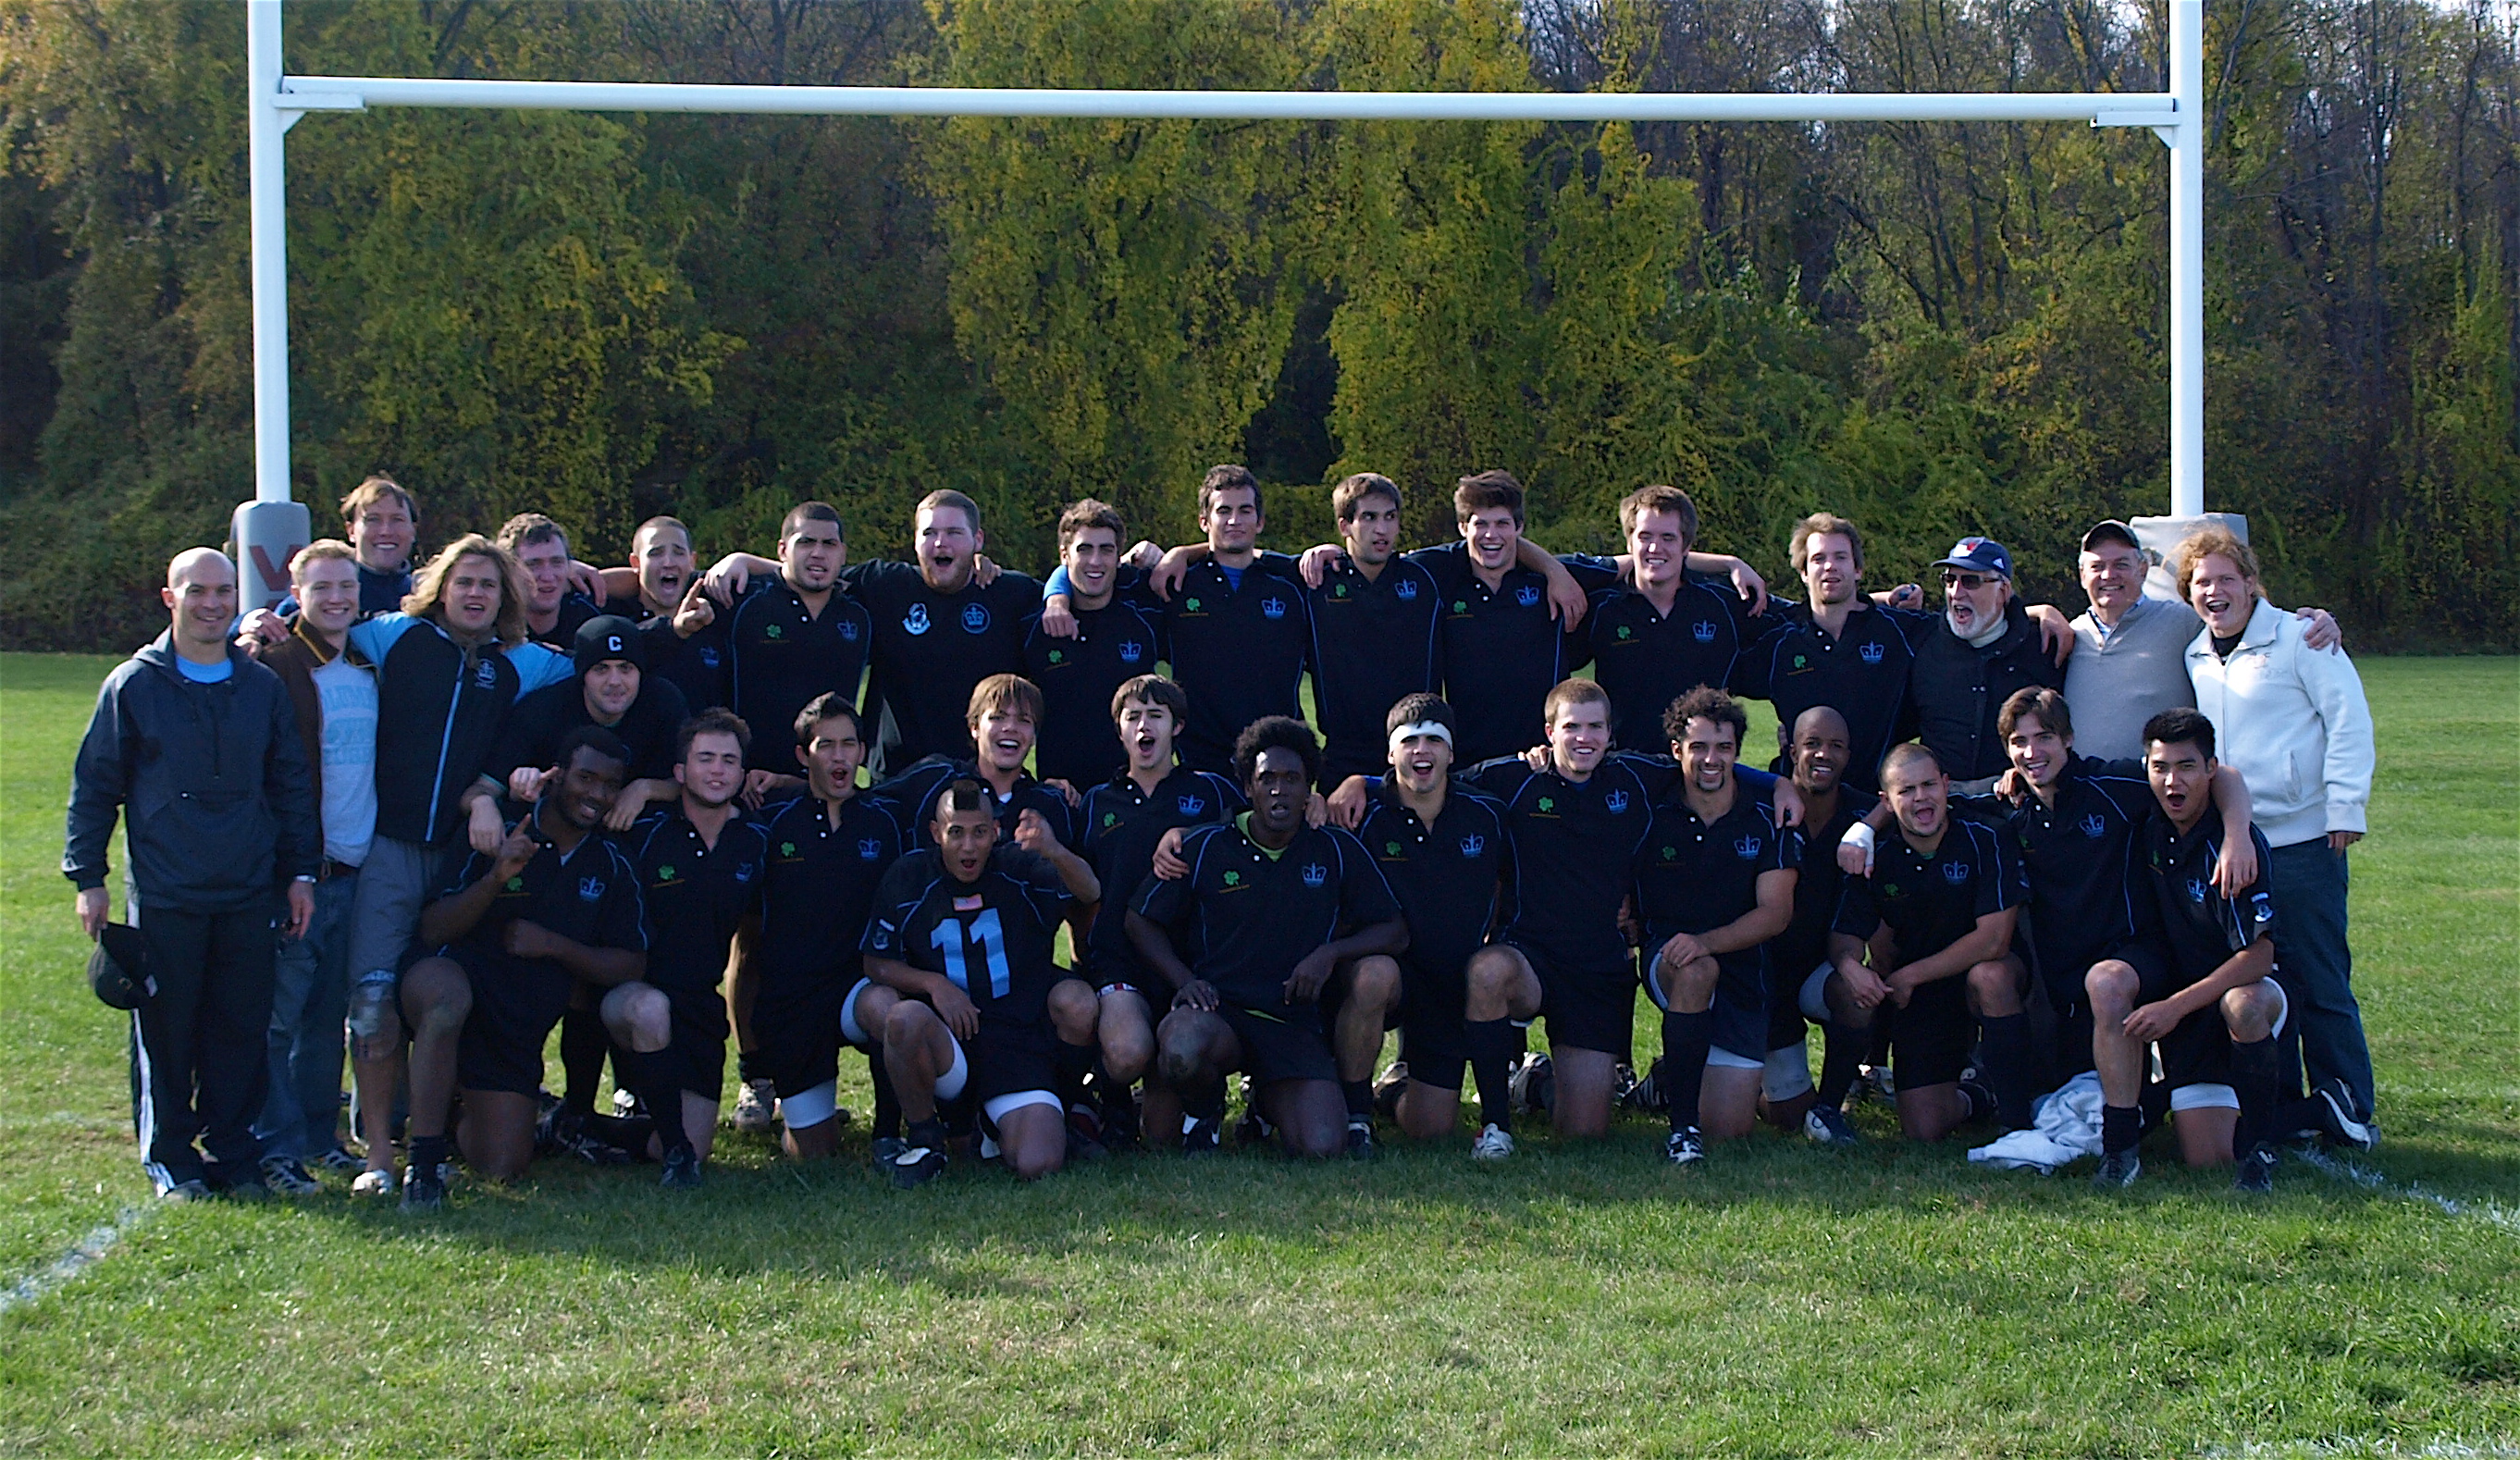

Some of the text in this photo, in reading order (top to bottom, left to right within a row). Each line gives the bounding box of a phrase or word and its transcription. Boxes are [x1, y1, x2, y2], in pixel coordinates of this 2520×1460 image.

[249, 544, 303, 591] V
[608, 636, 622, 651] C
[931, 908, 1010, 999] 11
